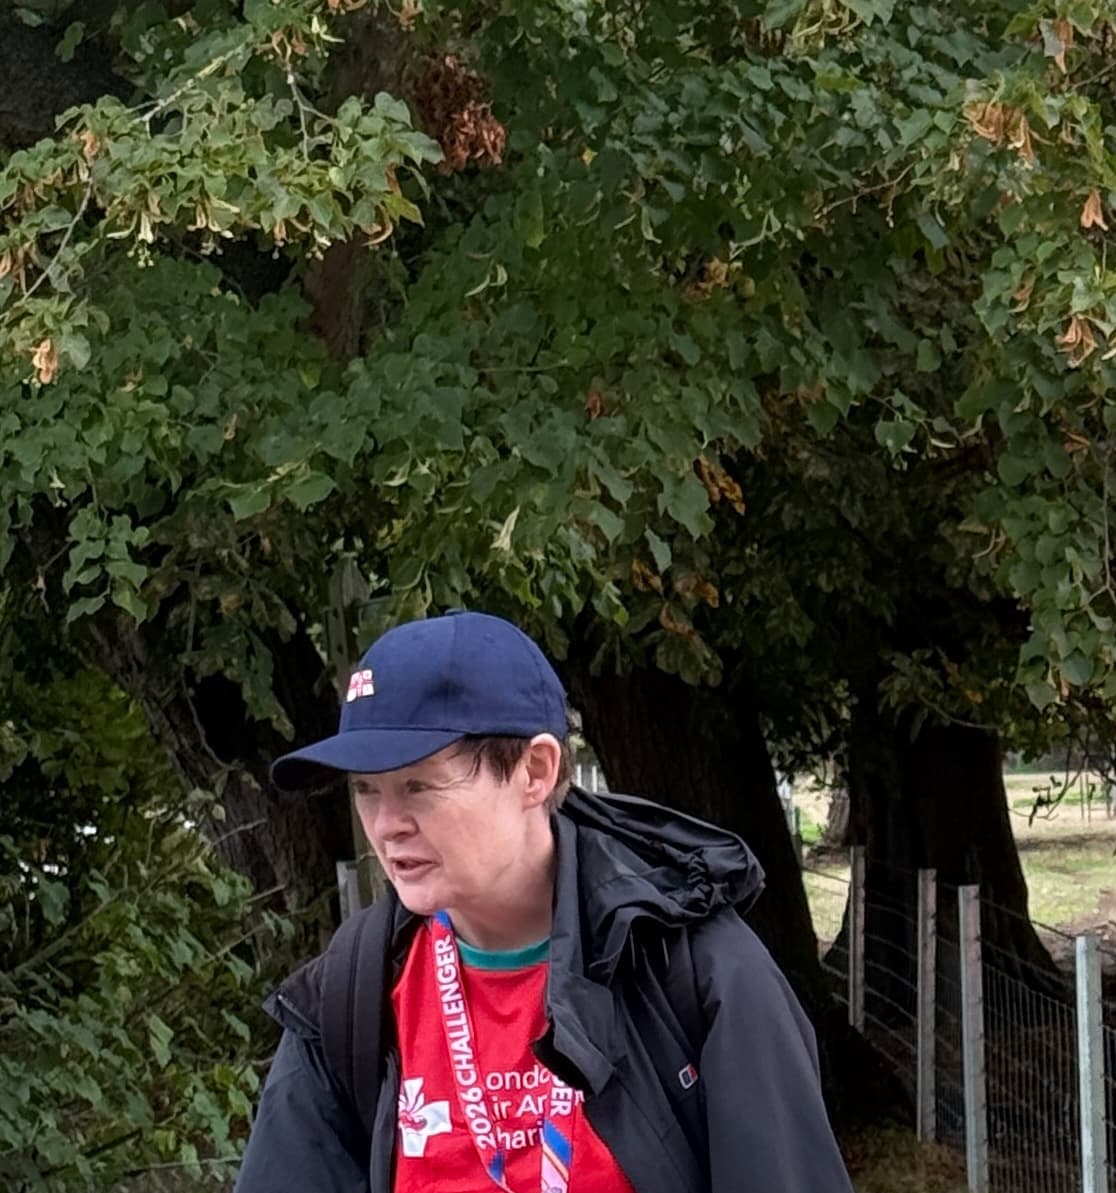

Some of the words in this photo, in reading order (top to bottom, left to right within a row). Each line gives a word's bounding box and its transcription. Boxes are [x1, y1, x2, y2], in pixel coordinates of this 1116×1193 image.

[435, 935, 478, 1087] CHALLENGER
[461, 1086, 497, 1149] 2026
[489, 1096, 512, 1121] ir
[498, 1120, 544, 1150] hari
